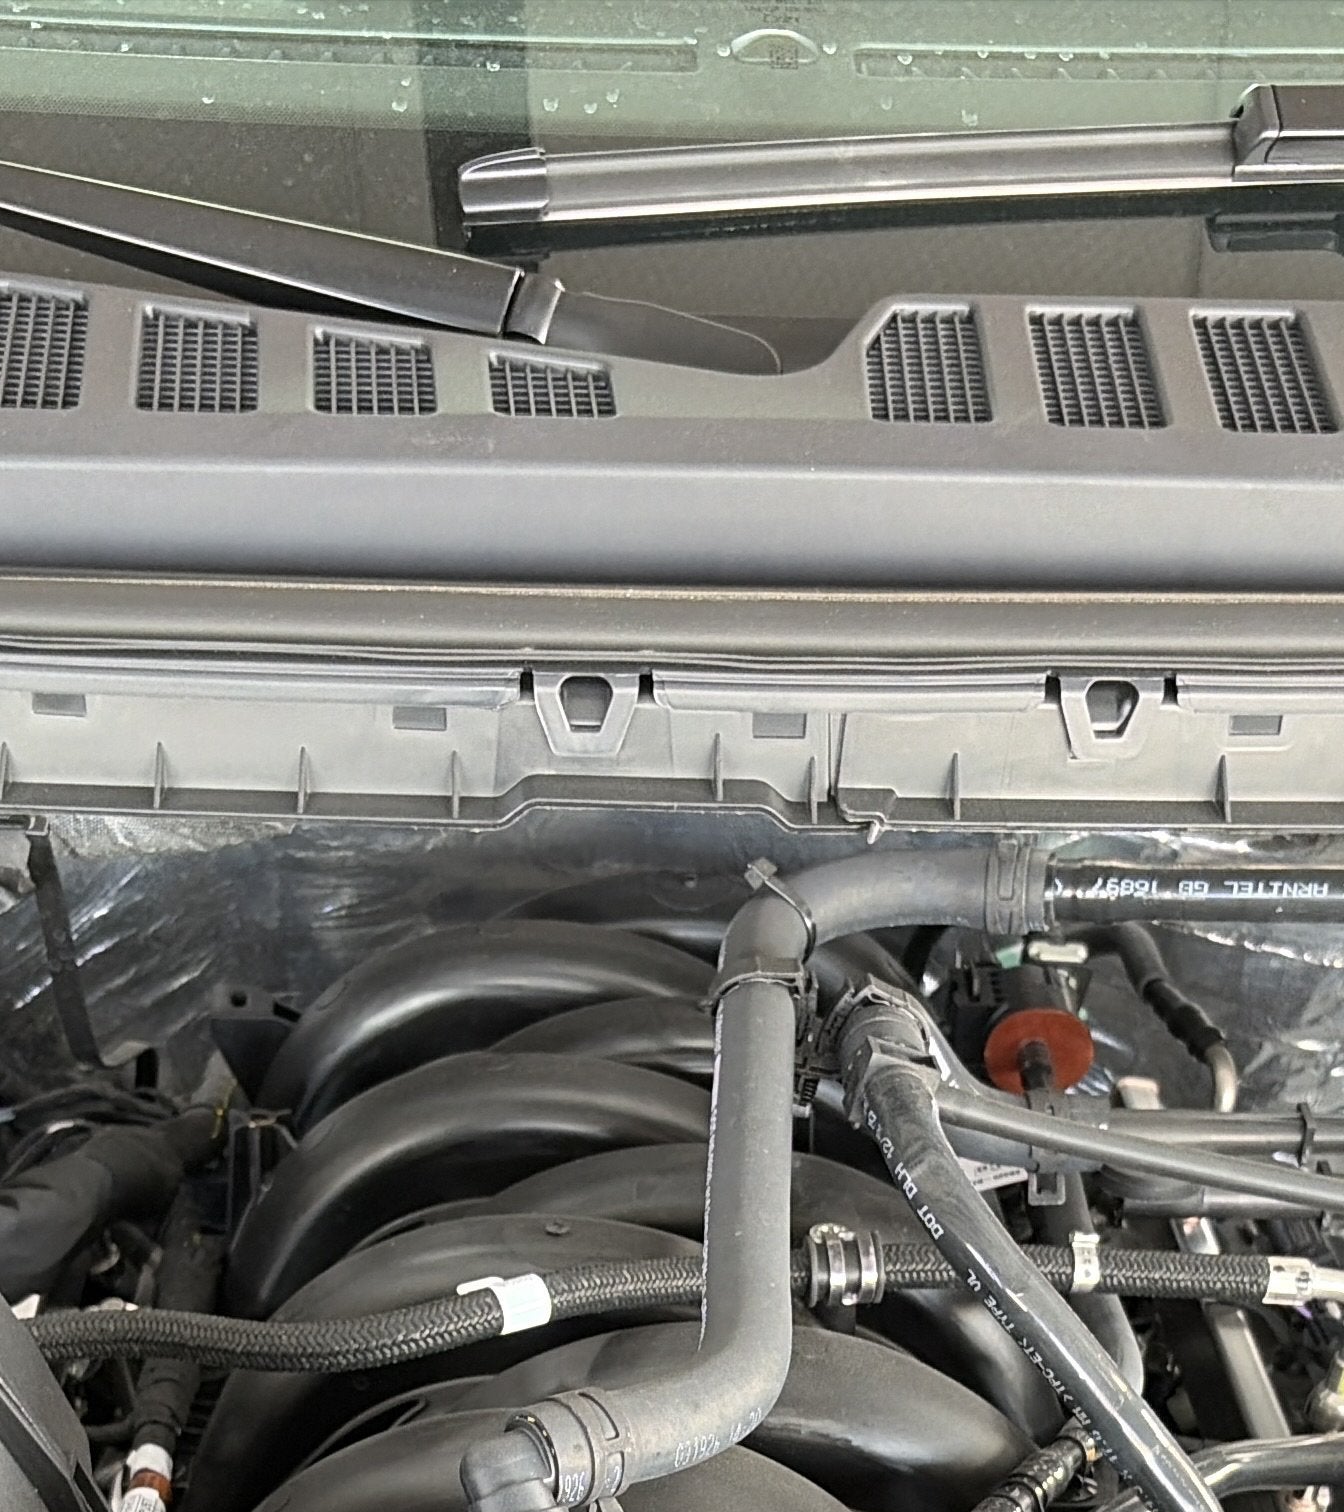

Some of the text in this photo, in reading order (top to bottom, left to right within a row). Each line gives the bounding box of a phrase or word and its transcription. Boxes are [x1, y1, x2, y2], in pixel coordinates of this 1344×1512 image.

[1092, 877, 1159, 900] 16897
[1178, 879, 1210, 898] GB
[1224, 880, 1329, 899] ARNITEL
[895, 1161, 918, 1200] DLH
[917, 1205, 945, 1240] DOT
[984, 1295, 1015, 1333] TYPE
